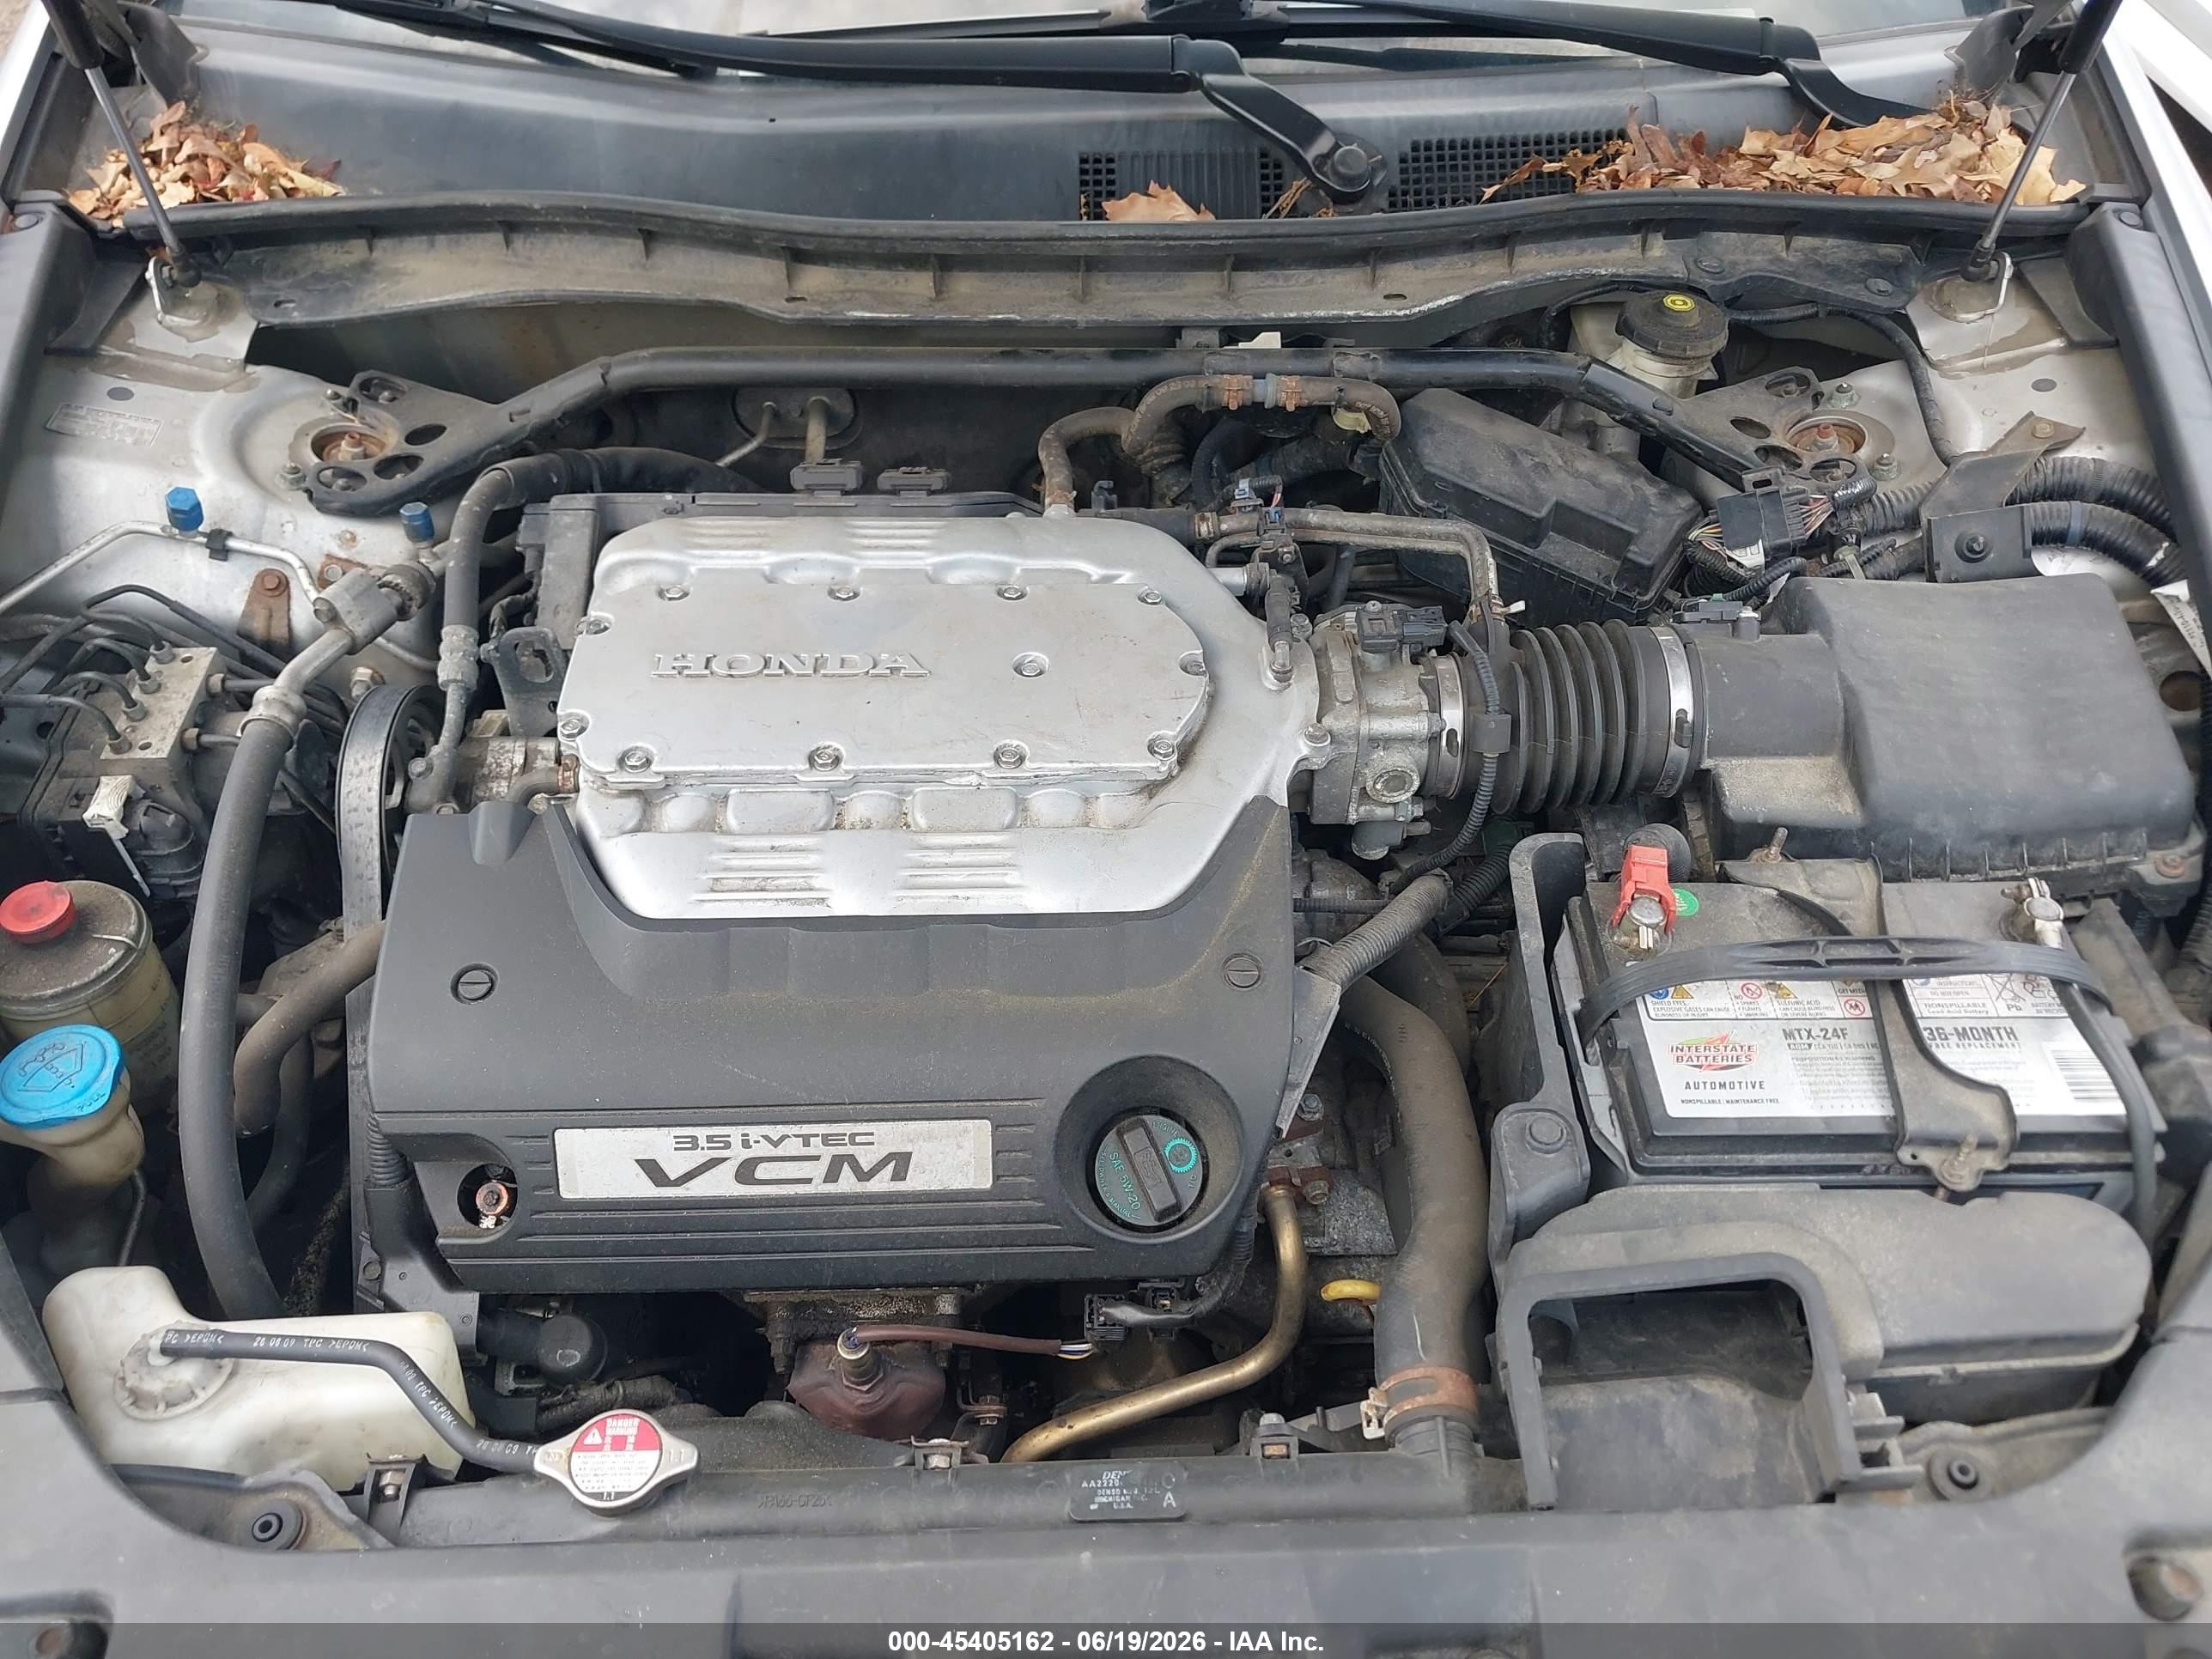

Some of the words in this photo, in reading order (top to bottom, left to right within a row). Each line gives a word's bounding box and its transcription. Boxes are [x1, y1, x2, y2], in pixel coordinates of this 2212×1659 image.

[651, 653, 931, 678] HONDA
[1782, 1027, 1848, 1041] MTX-24F
[1923, 1026, 2019, 1041] 36-MONTH
[1670, 1045, 1754, 1054] INTERSTATE
[1676, 1054, 1753, 1064] BATTERIES
[1685, 1081, 1765, 1091] AUTOMOTIVE
[1152, 1120, 1179, 1138] ENGINE
[673, 1133, 732, 1152] 3.5
[741, 1131, 875, 1151] i-VTEC
[634, 1151, 914, 1188] VCM
[1109, 1152, 1125, 1174] SAE
[1120, 1174, 1141, 1211] 5W-20
[605, 1418, 641, 1427] DANGER
[1163, 1491, 1176, 1508] A
